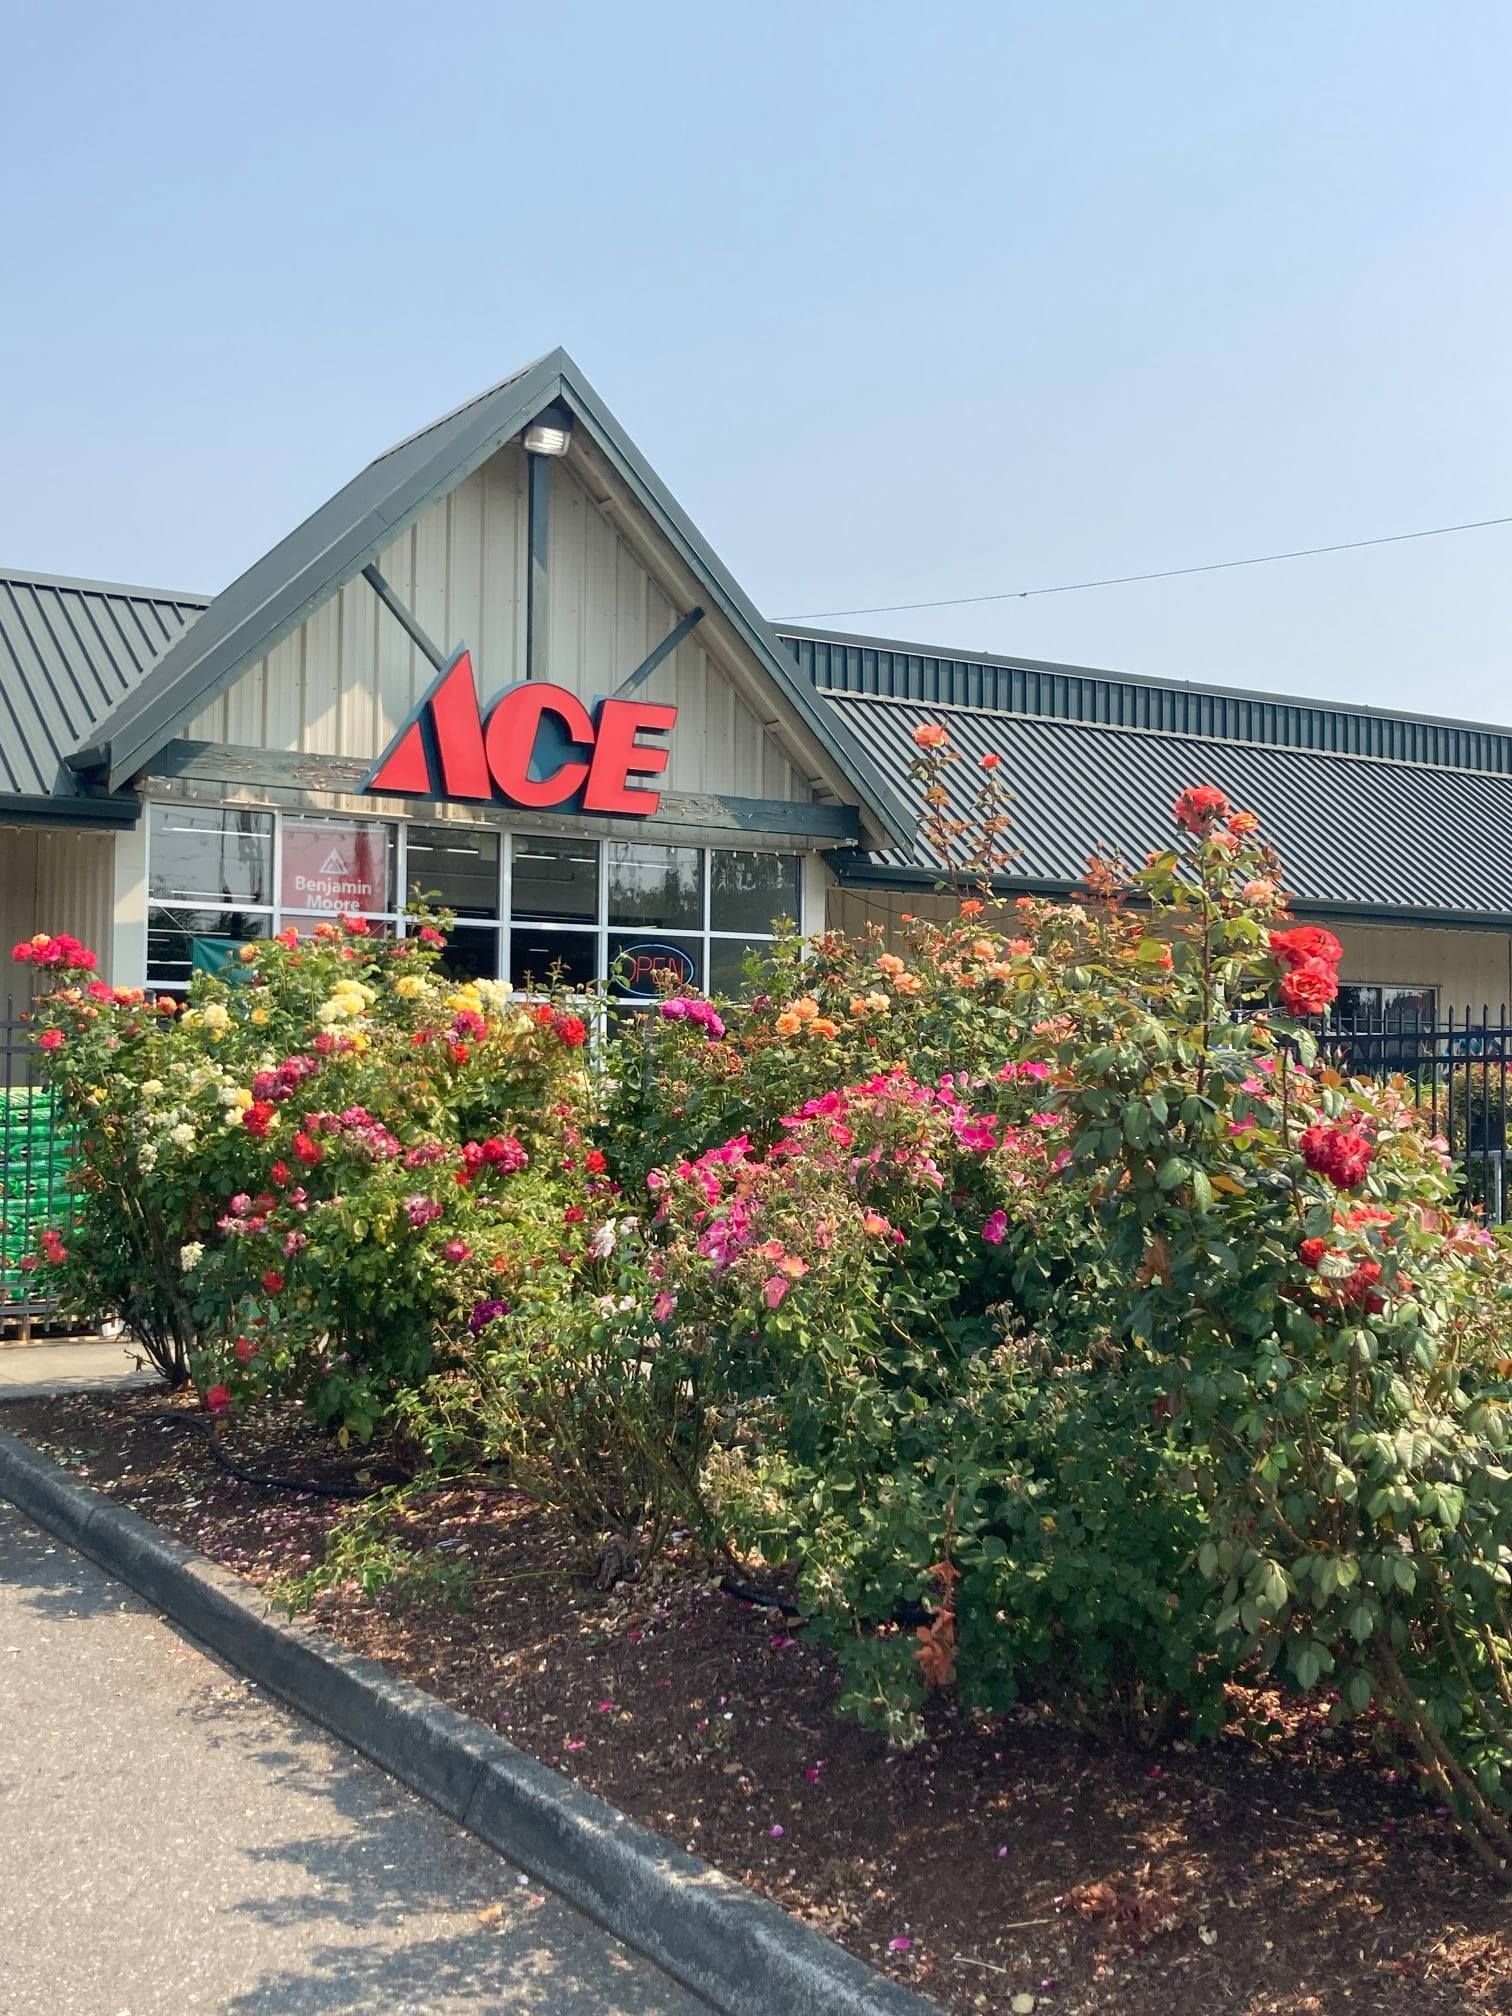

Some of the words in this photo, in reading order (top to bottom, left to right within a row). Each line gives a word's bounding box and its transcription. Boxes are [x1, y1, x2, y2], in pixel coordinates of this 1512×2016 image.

[367, 645, 679, 816] ACE
[295, 875, 372, 896] Benjamin
[306, 893, 361, 911] Moore
